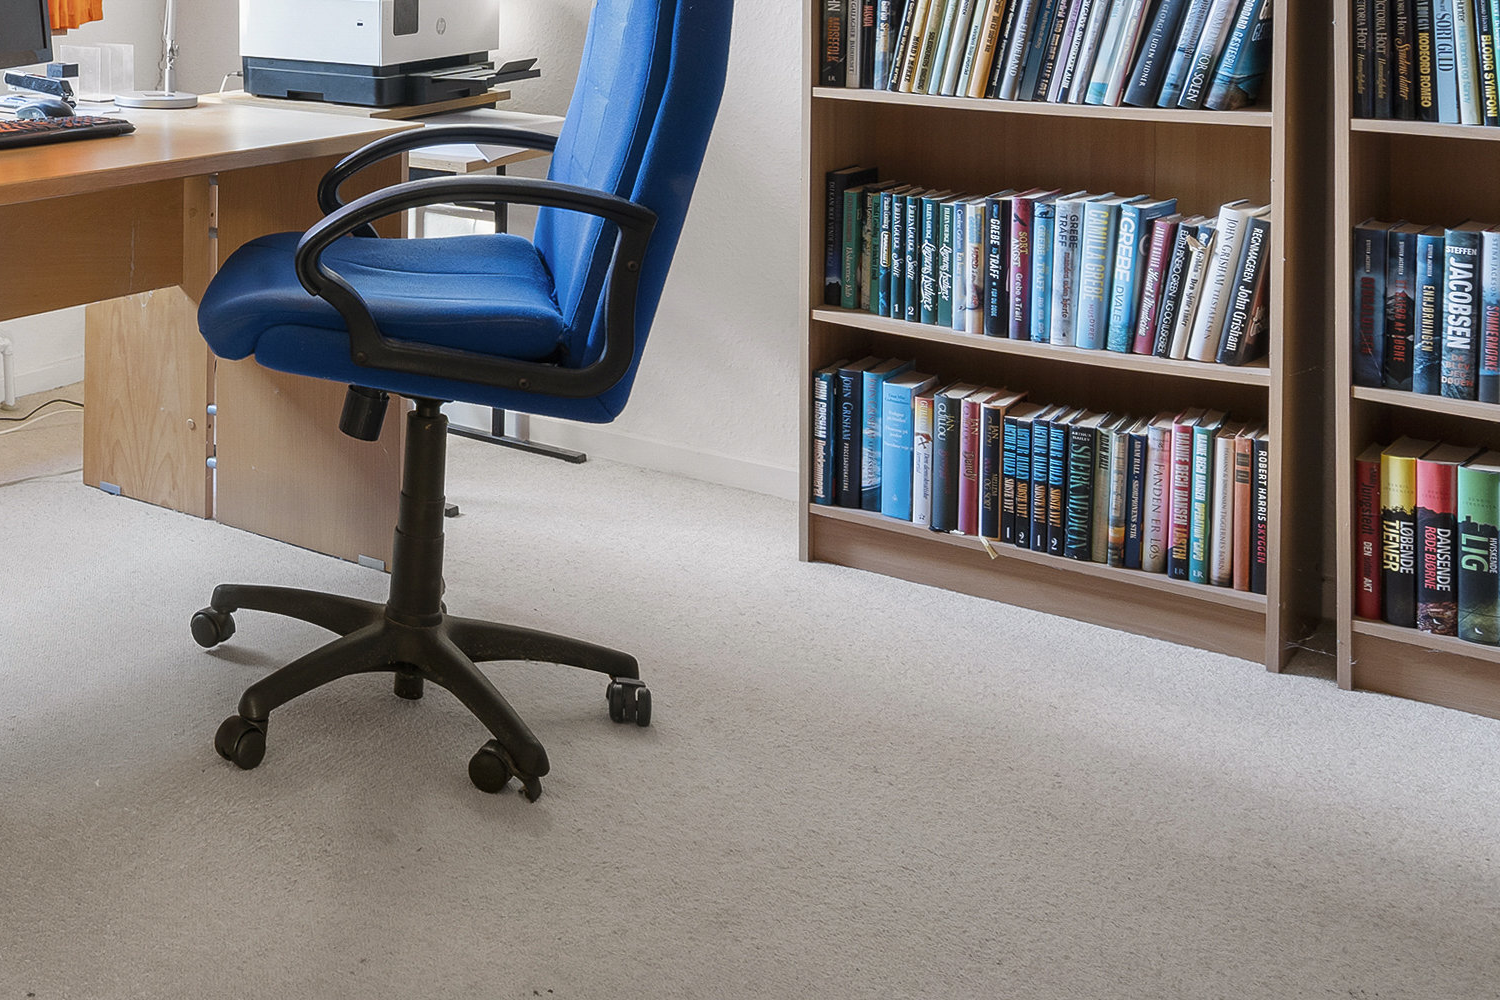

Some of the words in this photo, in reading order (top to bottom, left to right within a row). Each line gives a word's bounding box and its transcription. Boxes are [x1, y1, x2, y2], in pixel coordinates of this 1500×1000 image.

[1435, 13, 1452, 41] SORT
[1146, 33, 1160, 56] UDEN
[1198, 53, 1212, 70] FOR
[1419, 33, 1430, 74] KODEORD
[1437, 44, 1454, 71] GULD
[1481, 35, 1494, 71] BLODIG
[1139, 57, 1154, 87] VIDNER
[1187, 69, 1205, 102] SOLEN
[1420, 75, 1431, 107] ROMEO
[1483, 73, 1497, 117] SYMFONI
[990, 218, 1000, 245] GREBE
[1019, 232, 1028, 254] SORT
[1068, 215, 1078, 248] GREBE
[1085, 209, 1109, 259] CAMILLA
[1012, 238, 1021, 267] ANGST
[1114, 217, 1135, 282] GREBE
[1242, 228, 1264, 283] REGNMAGEREN
[1445, 246, 1477, 255] STEFFEN
[1083, 263, 1105, 302] GREBE
[1236, 285, 1252, 310] John
[1113, 285, 1124, 321] DVALE
[1421, 285, 1435, 352] ENHJØRNINGEN
[1446, 257, 1473, 349] JACOBSEN
[1226, 310, 1247, 351] Grisham
[1485, 306, 1499, 371] SOMMERMØRKE
[840, 376, 854, 398] JOHN
[842, 402, 853, 440] GRISHAM
[1099, 454, 1108, 471] HALL
[1175, 432, 1190, 461] HANNE
[1174, 463, 1189, 487] BECH
[1258, 451, 1267, 485] ROBERT
[1151, 464, 1165, 512] FANDEN
[1258, 487, 1267, 521] HARRIS
[1173, 489, 1188, 525] HANSEN
[1151, 519, 1162, 532] ER
[1424, 526, 1436, 552] RØDE
[1149, 538, 1160, 560] LØS
[1172, 527, 1187, 560] LASTEN
[1257, 524, 1266, 563] SKYGGEN
[1363, 541, 1372, 556] DEN
[1383, 520, 1399, 572] TJENER
[1400, 521, 1414, 574] LØBENDE
[1436, 528, 1451, 592] DANSENDE
[1461, 533, 1488, 572] LIG
[1489, 537, 1497, 574] HVISKENDE
[1363, 577, 1372, 592] AKT
[1424, 554, 1436, 590] BJØRNE
